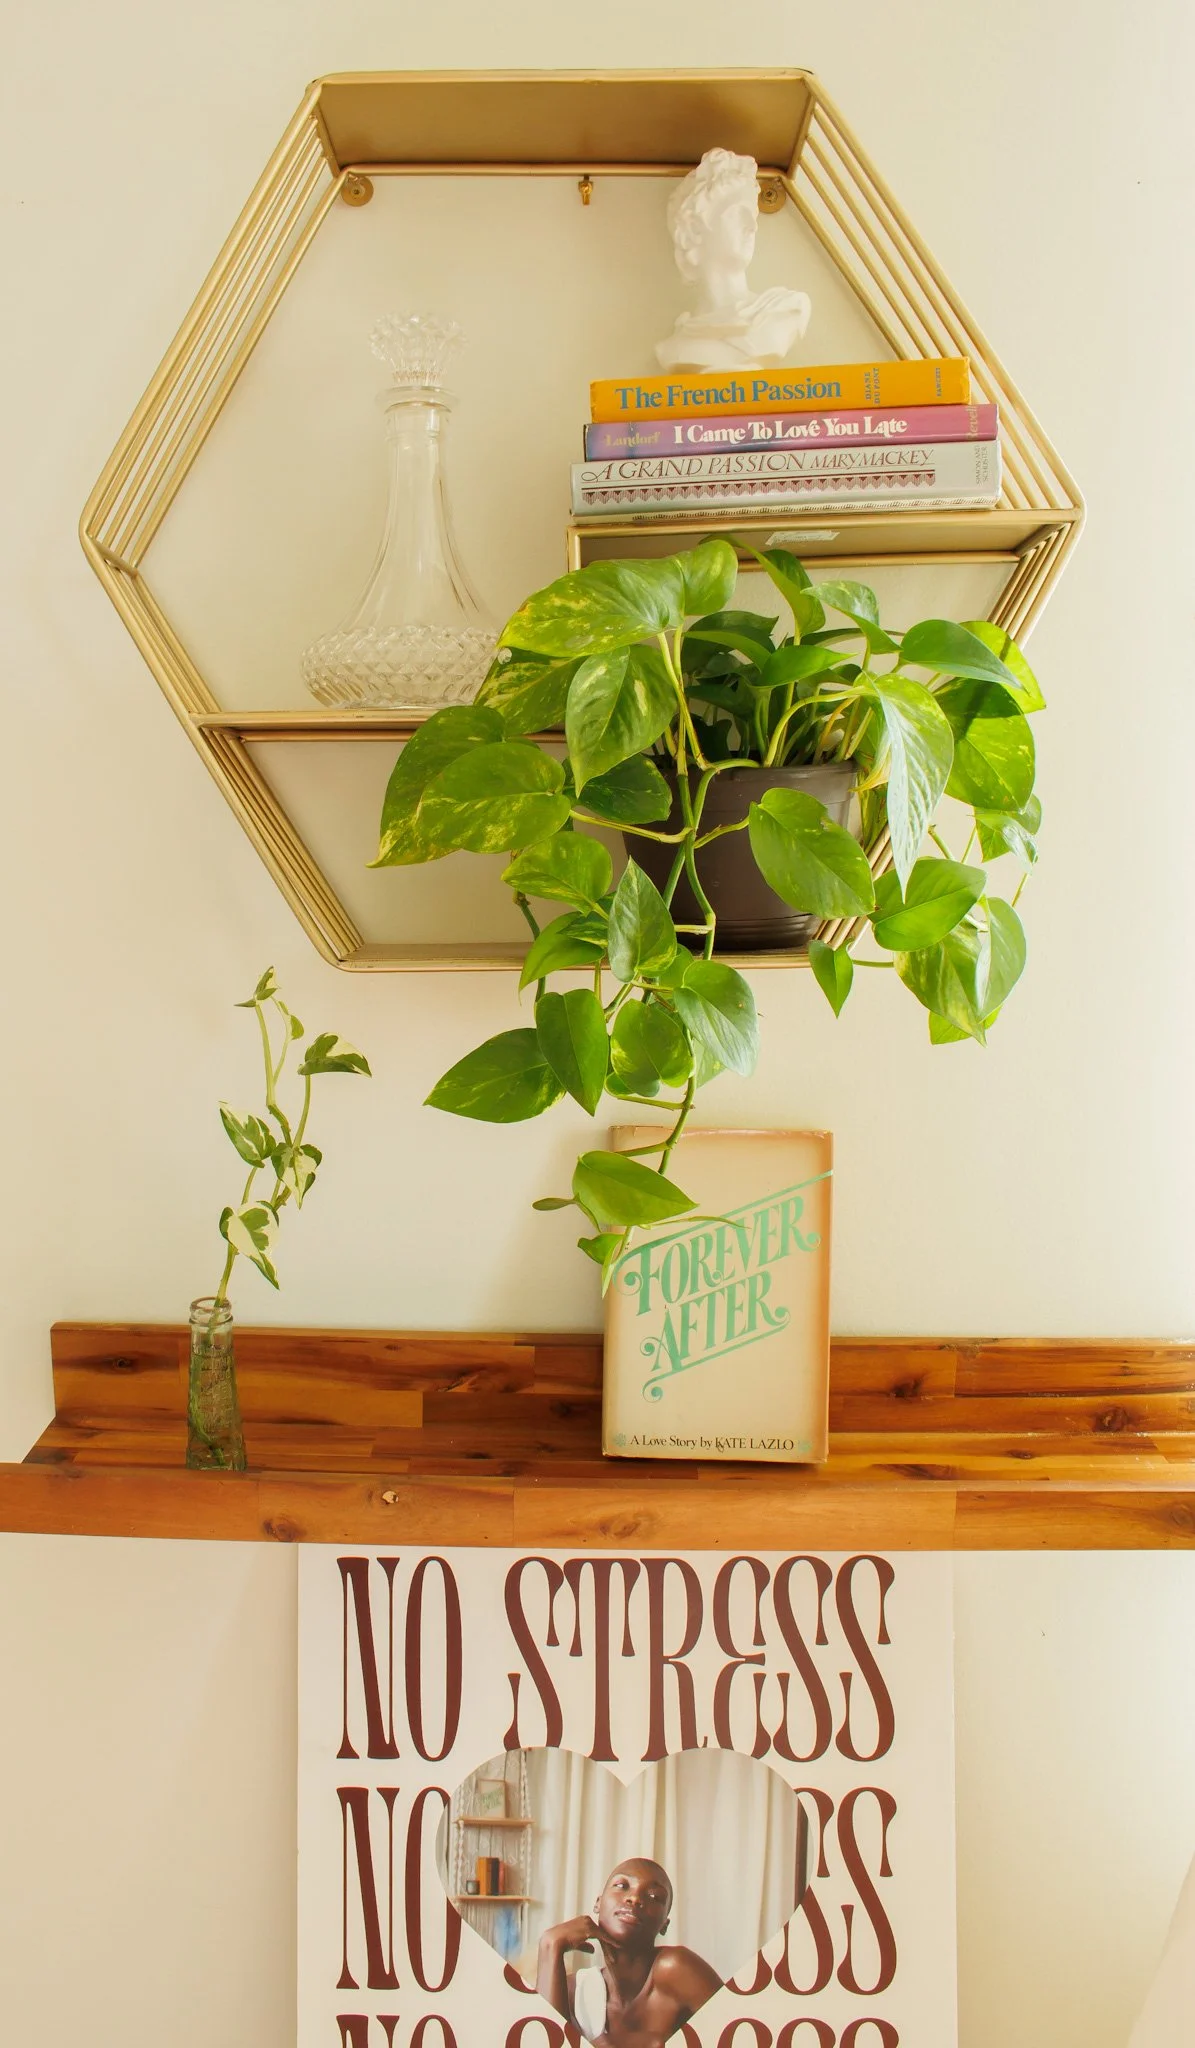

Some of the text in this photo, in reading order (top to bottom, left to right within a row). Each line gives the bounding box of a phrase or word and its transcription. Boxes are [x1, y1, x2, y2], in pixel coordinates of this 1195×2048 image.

[614, 378, 842, 410] The French Passion
[863, 371, 871, 400] DIANE
[674, 416, 908, 445] I Came To Love You Late
[581, 449, 934, 481] A GRAND PASSION MARY MACKEY
[614, 1196, 822, 1316] FOREVER
[640, 1270, 791, 1374] AFTER
[630, 1435, 794, 1453] A Love Story by KATE LAZLO
[336, 1554, 896, 1762] NO STRESS
[336, 1786, 463, 1992] NO
